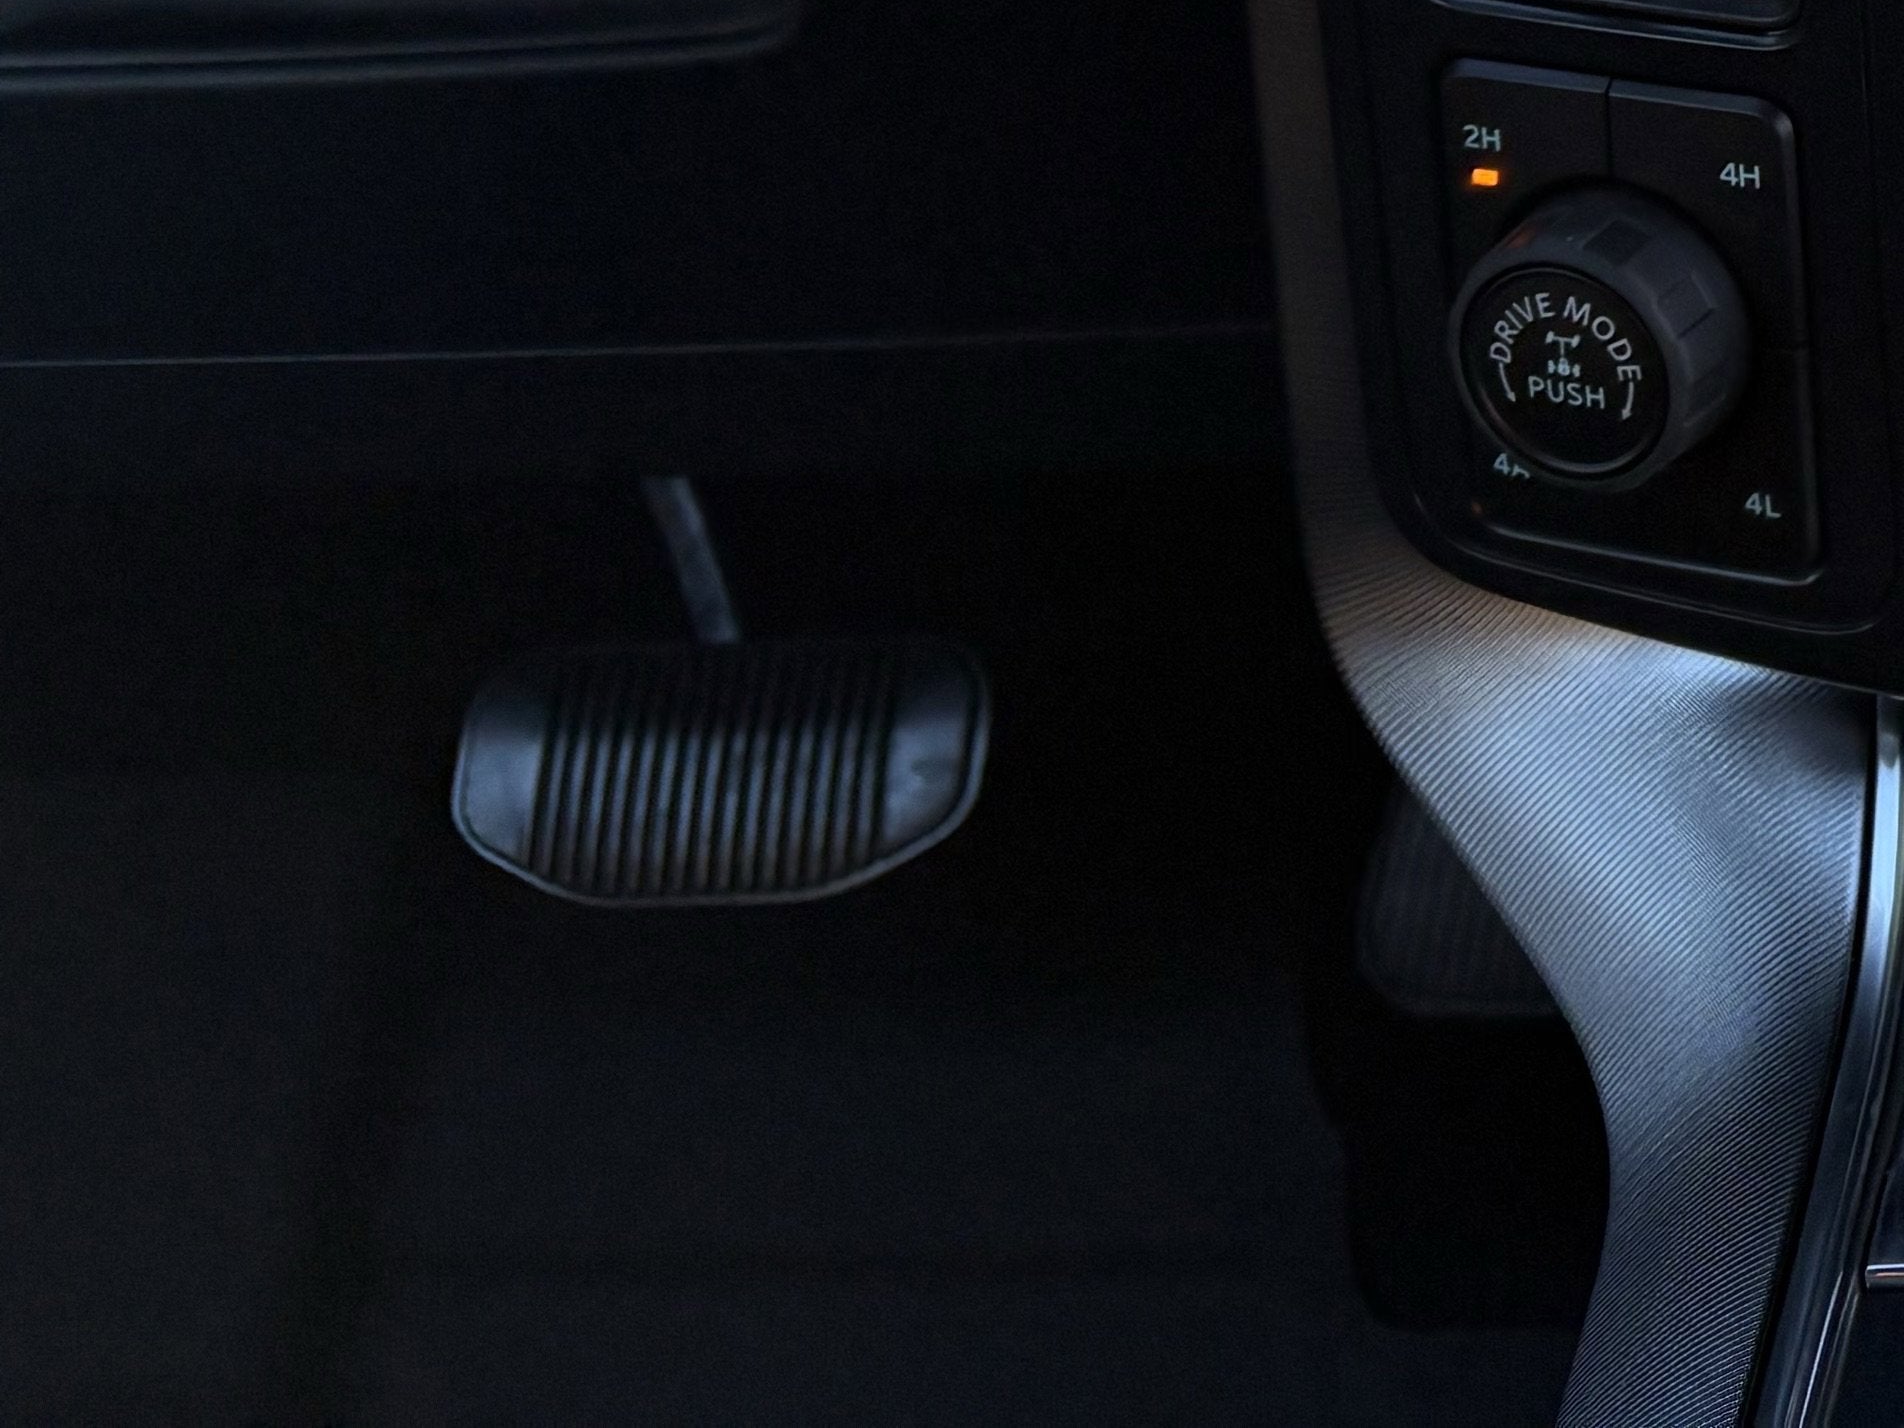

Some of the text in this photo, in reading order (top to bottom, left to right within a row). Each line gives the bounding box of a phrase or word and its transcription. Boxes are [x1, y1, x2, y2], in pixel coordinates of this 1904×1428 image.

[1462, 124, 1502, 151] 2H
[1719, 162, 1761, 189] 4H
[1489, 292, 1643, 382] DRIVE MODE
[1527, 375, 1606, 410] PUSH
[1745, 493, 1782, 519] 4L
